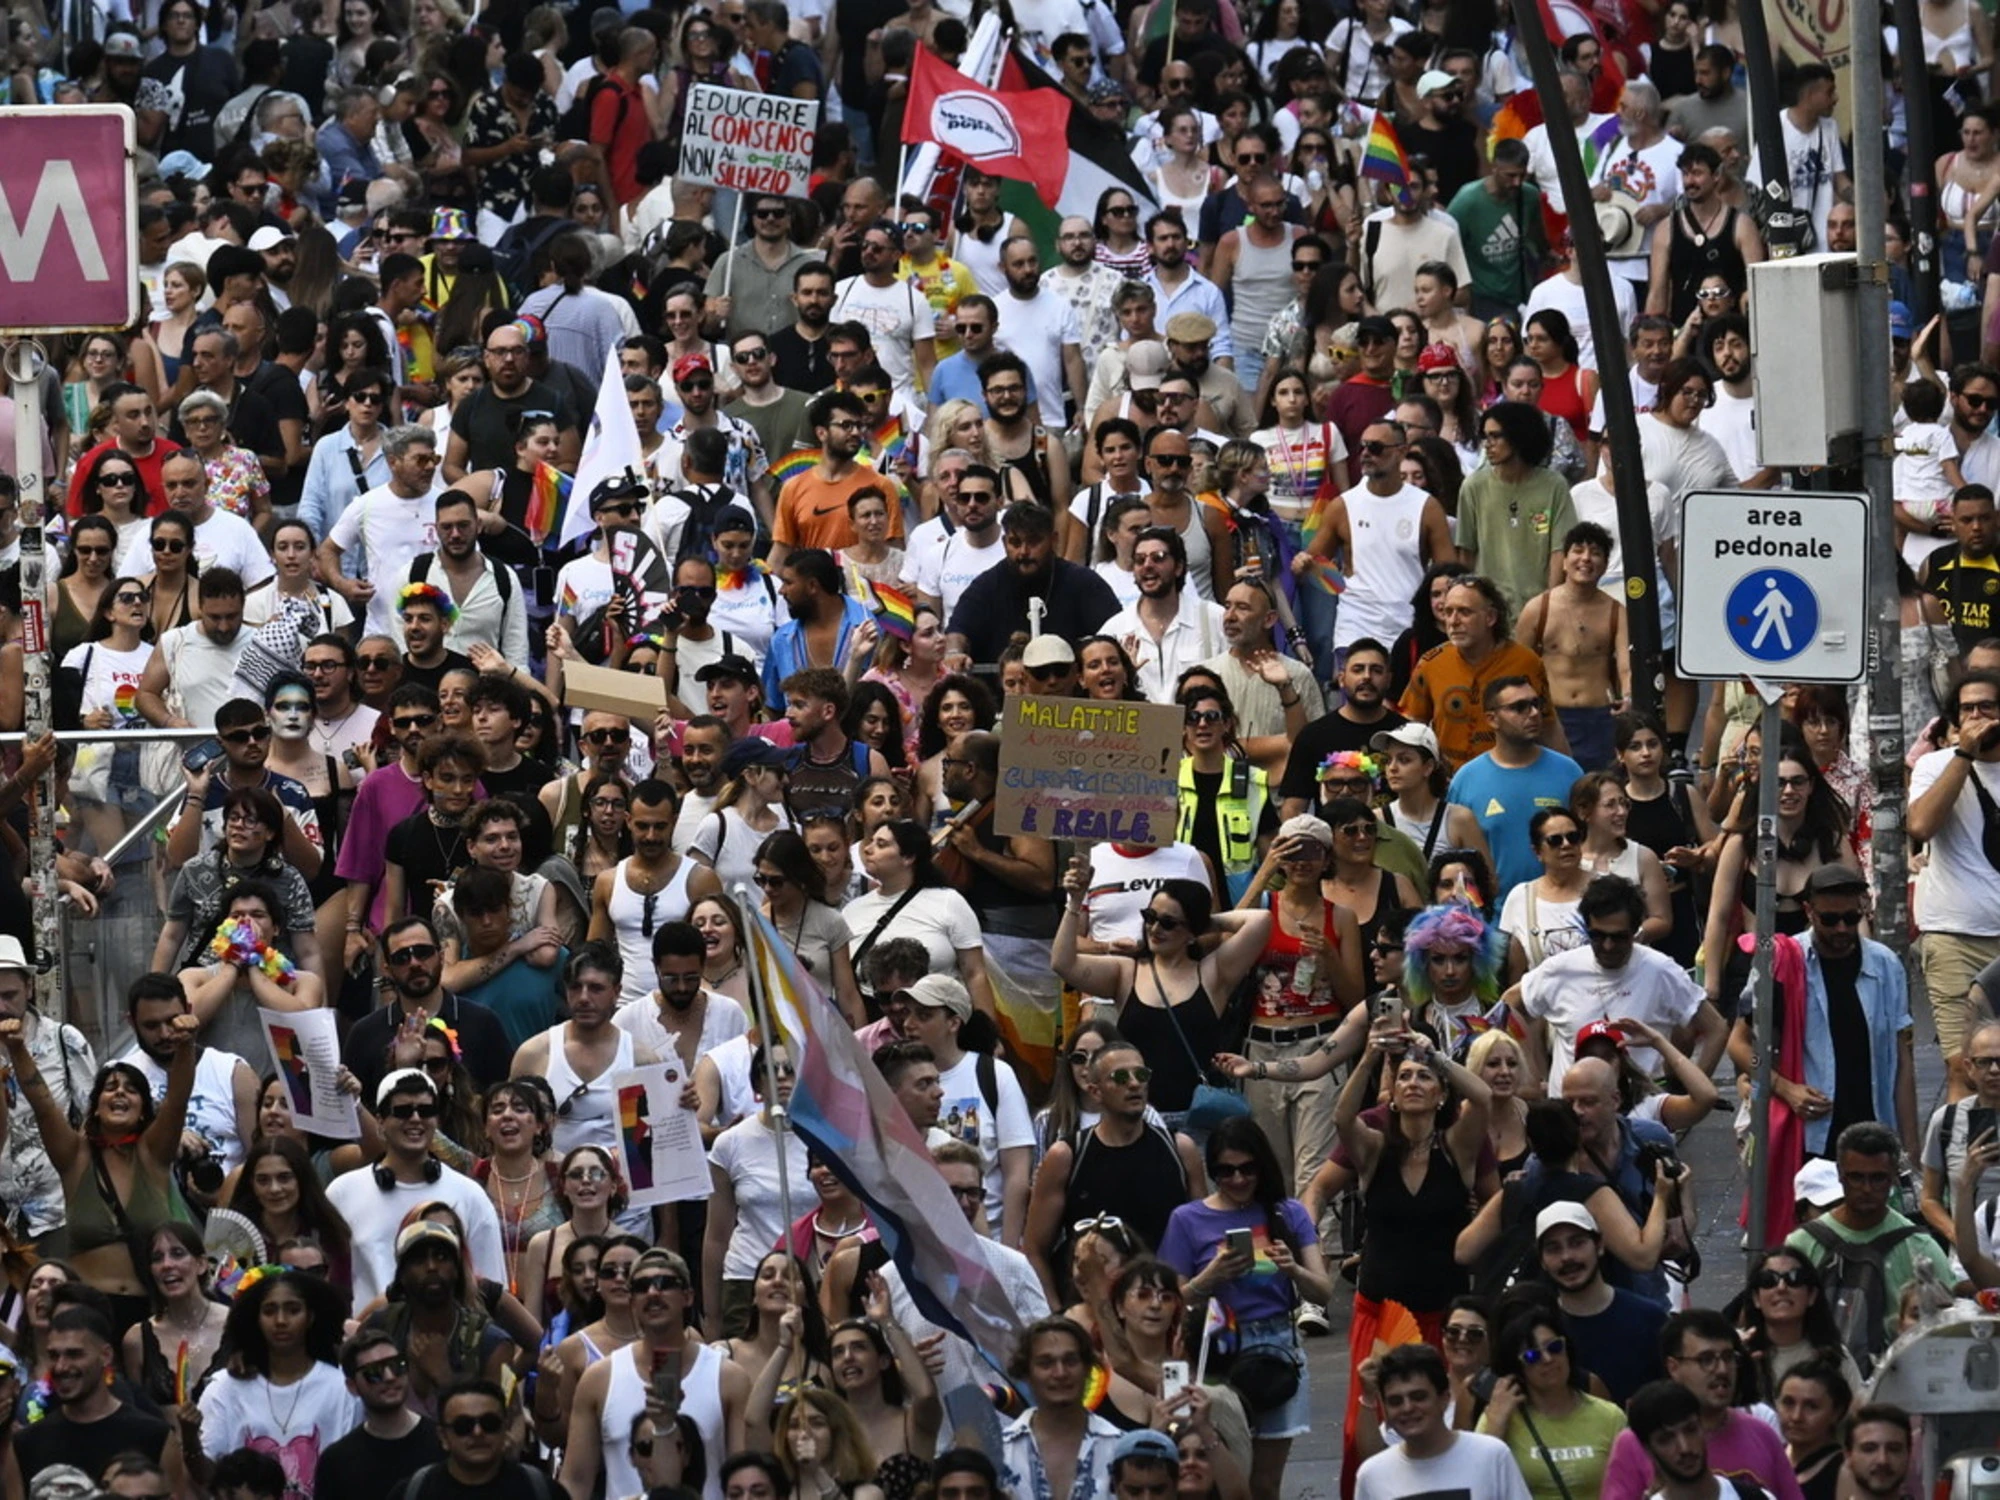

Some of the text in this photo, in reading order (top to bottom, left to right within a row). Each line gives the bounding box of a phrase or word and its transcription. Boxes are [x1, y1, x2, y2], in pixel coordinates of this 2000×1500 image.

[691, 89, 809, 127] EDUCARE
[686, 112, 815, 156] AL CONSENSO
[681, 144, 715, 176] NON
[714, 162, 791, 194] SILENZIO
[0, 160, 110, 282] M
[1747, 509, 1802, 526] area
[1715, 536, 1833, 559] pedonale
[1019, 700, 1139, 735] MALATTIE
[1119, 878, 1165, 893] Levi
